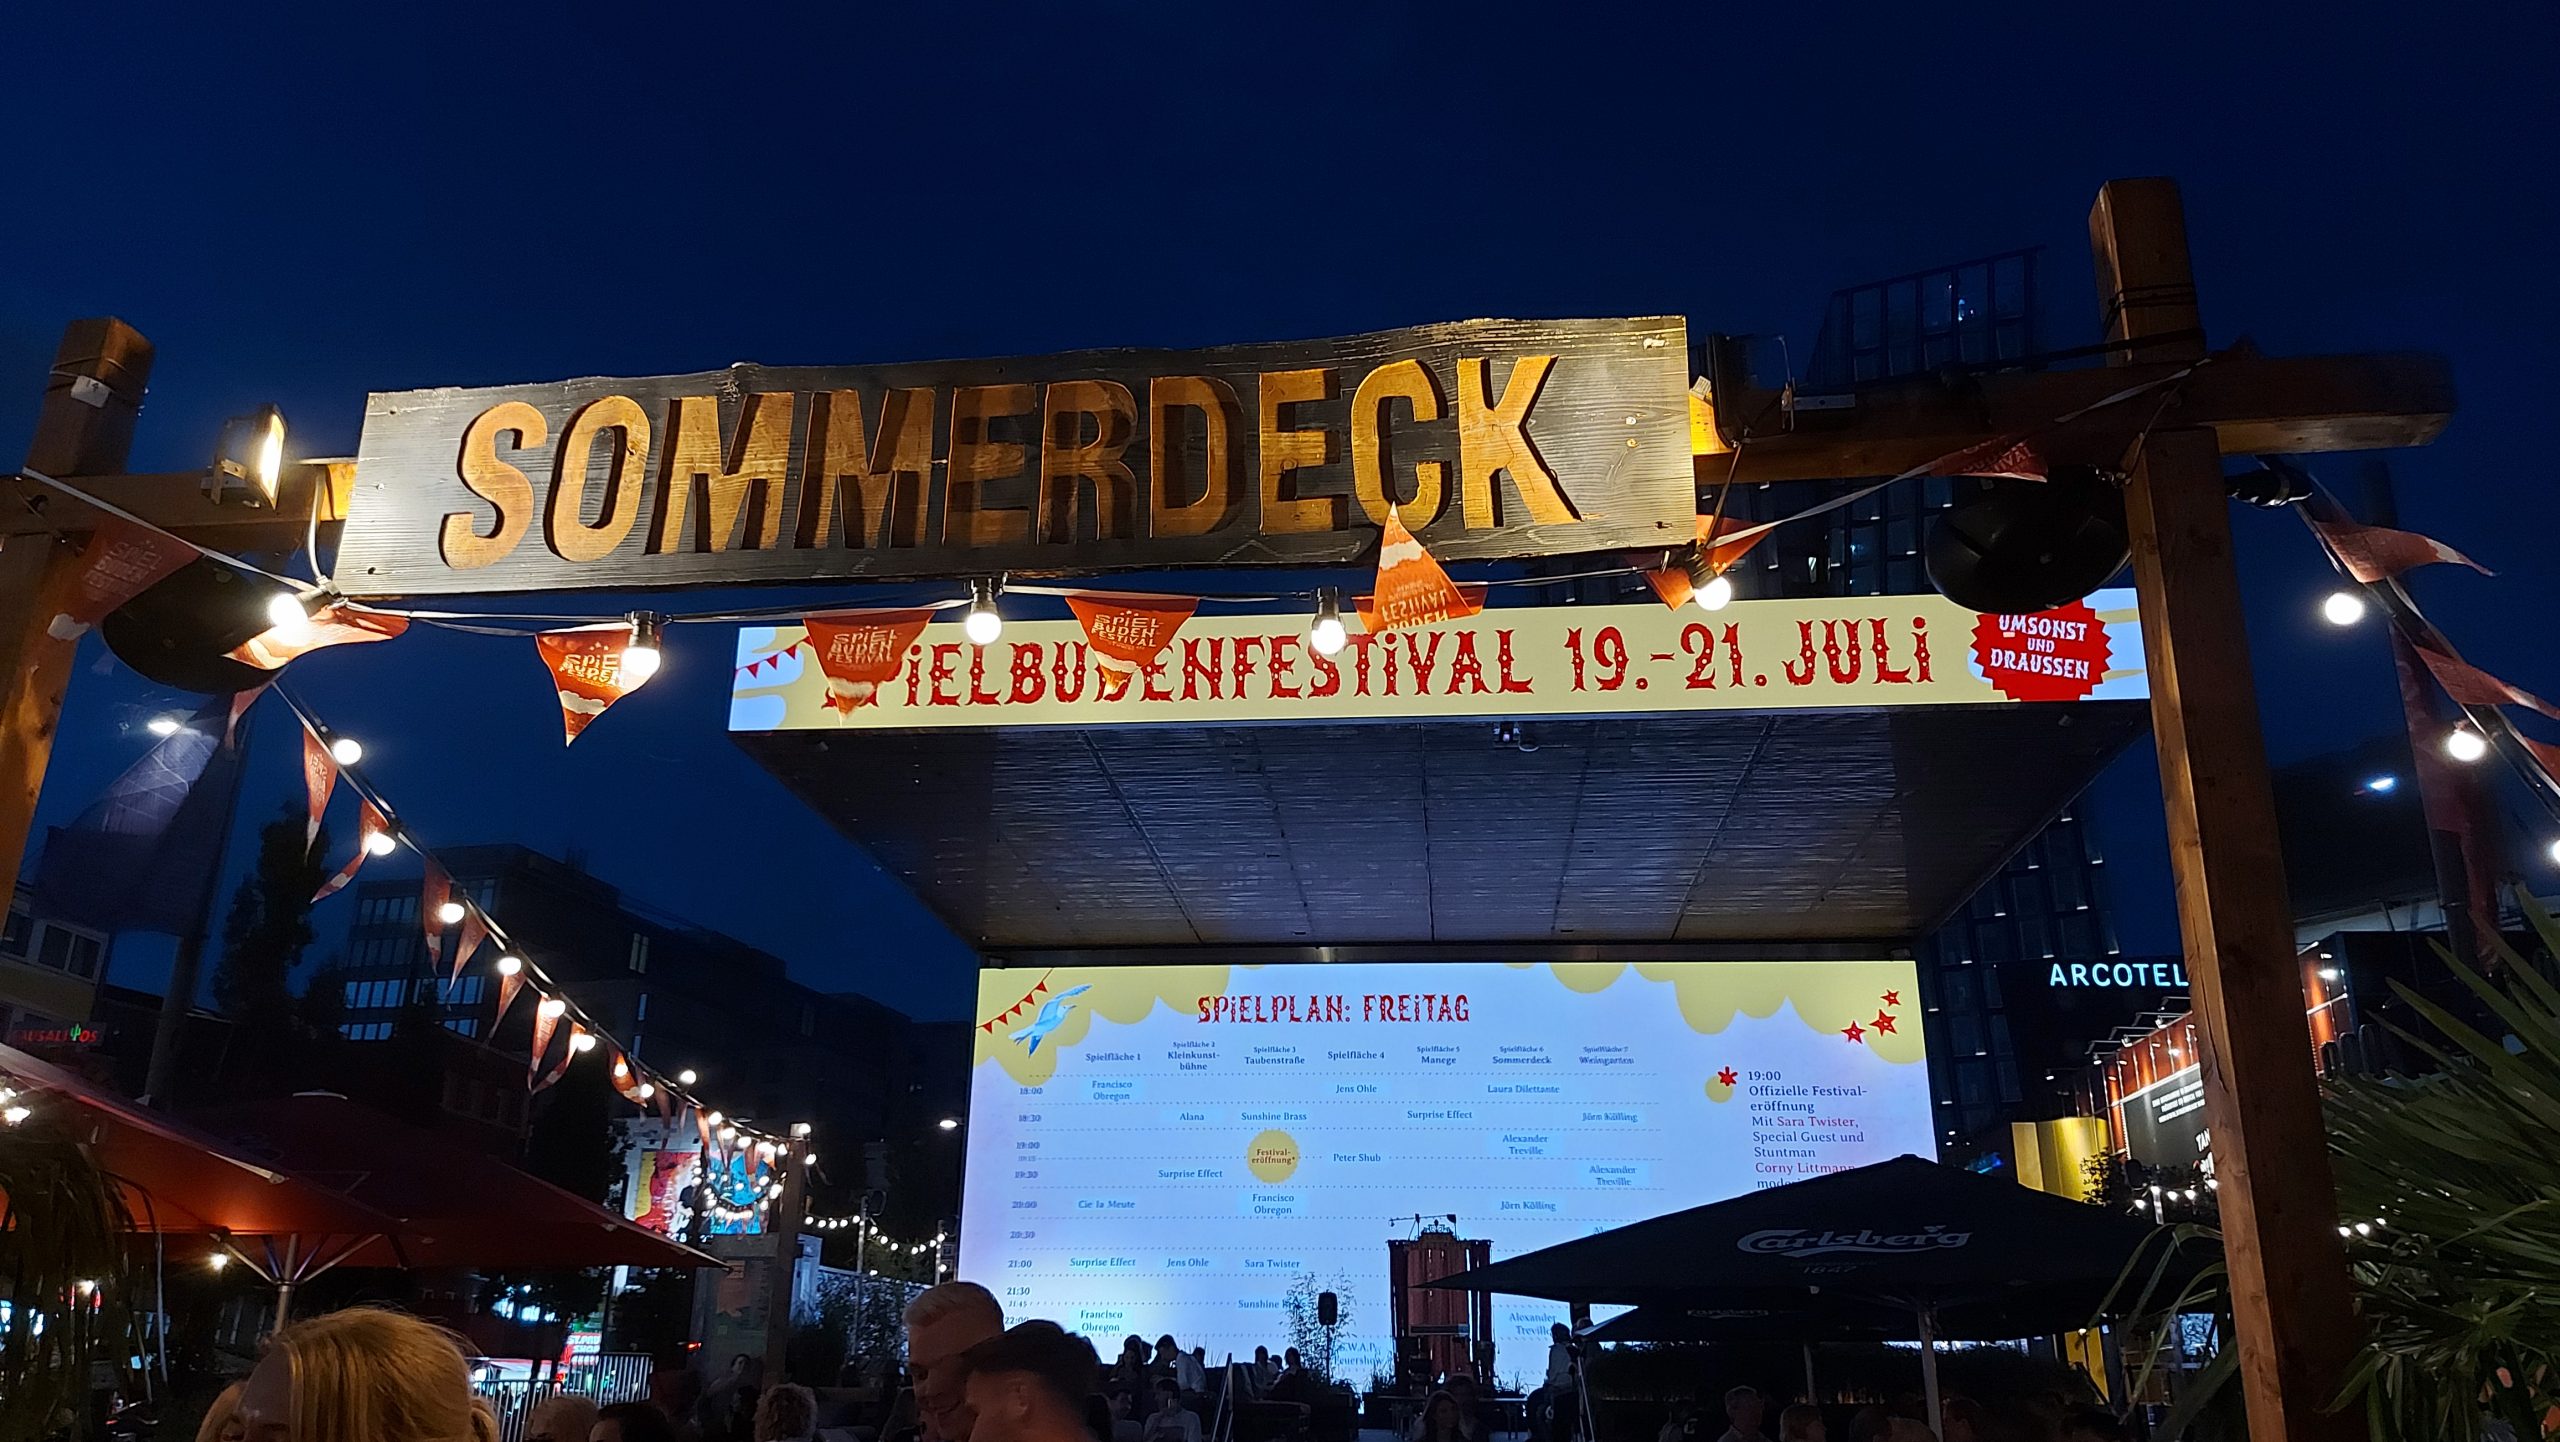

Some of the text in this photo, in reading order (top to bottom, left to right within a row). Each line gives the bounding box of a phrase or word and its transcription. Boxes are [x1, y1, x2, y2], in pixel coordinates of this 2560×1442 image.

[440, 355, 1581, 570] SOMMERDECK
[1093, 622, 1156, 639] BUDEN
[1999, 614, 2088, 642] UMSONST
[1091, 627, 1157, 648] FESTIVAL
[2027, 637, 2055, 653] UND
[565, 653, 621, 670] SPiE
[821, 629, 1534, 708] iELBUENFESTiVAL
[1564, 622, 1767, 693] 19.-21.
[1990, 648, 2090, 680] DRAUSSEN
[2050, 963, 2190, 987] ARCOTEL
[1085, 1052, 1135, 1063] Spielfläche
[1167, 1051, 1221, 1060] Kleinkunst-
[1244, 1056, 1305, 1065] Taubenstraße
[1327, 1051, 1377, 1060] Spielfläche
[1492, 1056, 1552, 1064] Sommerdeck
[1179, 1062, 1208, 1070] bühne
[1421, 1056, 1457, 1066] Manege
[1579, 1056, 1635, 1066] Weingarten
[1748, 1071, 1781, 1081] 19:00
[1091, 1080, 1132, 1089] Francisco
[1335, 1084, 1377, 1094] Jens Ohle
[1487, 1085, 1560, 1093] Laura Dilettante
[1749, 1085, 1868, 1096] Offizielle Festival-
[1093, 1092, 1130, 1102] Obregon
[1750, 1101, 1815, 1114] eröffnung
[1179, 1112, 1205, 1121] Alana
[1241, 1112, 1307, 1121] Sunshine Brass
[1407, 1110, 1473, 1120] Surprise Effect
[1752, 1116, 1859, 1128] Mit Sara Twister,
[1502, 1134, 1548, 1143] Alexander
[1753, 1131, 1864, 1144] Special Guest und
[1256, 1148, 1291, 1156] Festival-
[1508, 1146, 1543, 1155] Treville
[1754, 1147, 1816, 1158] Stuntman
[1333, 1153, 1381, 1162] Peter Shub
[1589, 1165, 1637, 1174] Alexander
[1755, 1162, 1793, 1175] Corny
[1158, 1169, 1223, 1180] Surprise Effect
[1596, 1177, 1632, 1186] Treville
[1252, 1193, 1295, 1202] Francisco
[1078, 1200, 1136, 1209] Cie la Meute
[1500, 1201, 1556, 1212] Jörn Kölling
[1254, 1206, 1292, 1216] Obregon
[1735, 1224, 1974, 1258] Carlsberg
[1008, 1259, 1033, 1268] 21:00
[1069, 1257, 1136, 1269] Surprise Effect
[1166, 1258, 1210, 1268] Jens Ohle
[1244, 1259, 1301, 1268] Sara Twister
[1803, 1264, 1858, 1275] 1847
[1006, 1286, 1030, 1296] 21:30
[1238, 1299, 1280, 1309] Sunshine
[1080, 1309, 1123, 1319] Francisco
[1509, 1313, 1556, 1323] Alexander
[1081, 1322, 1120, 1333] Obregon
